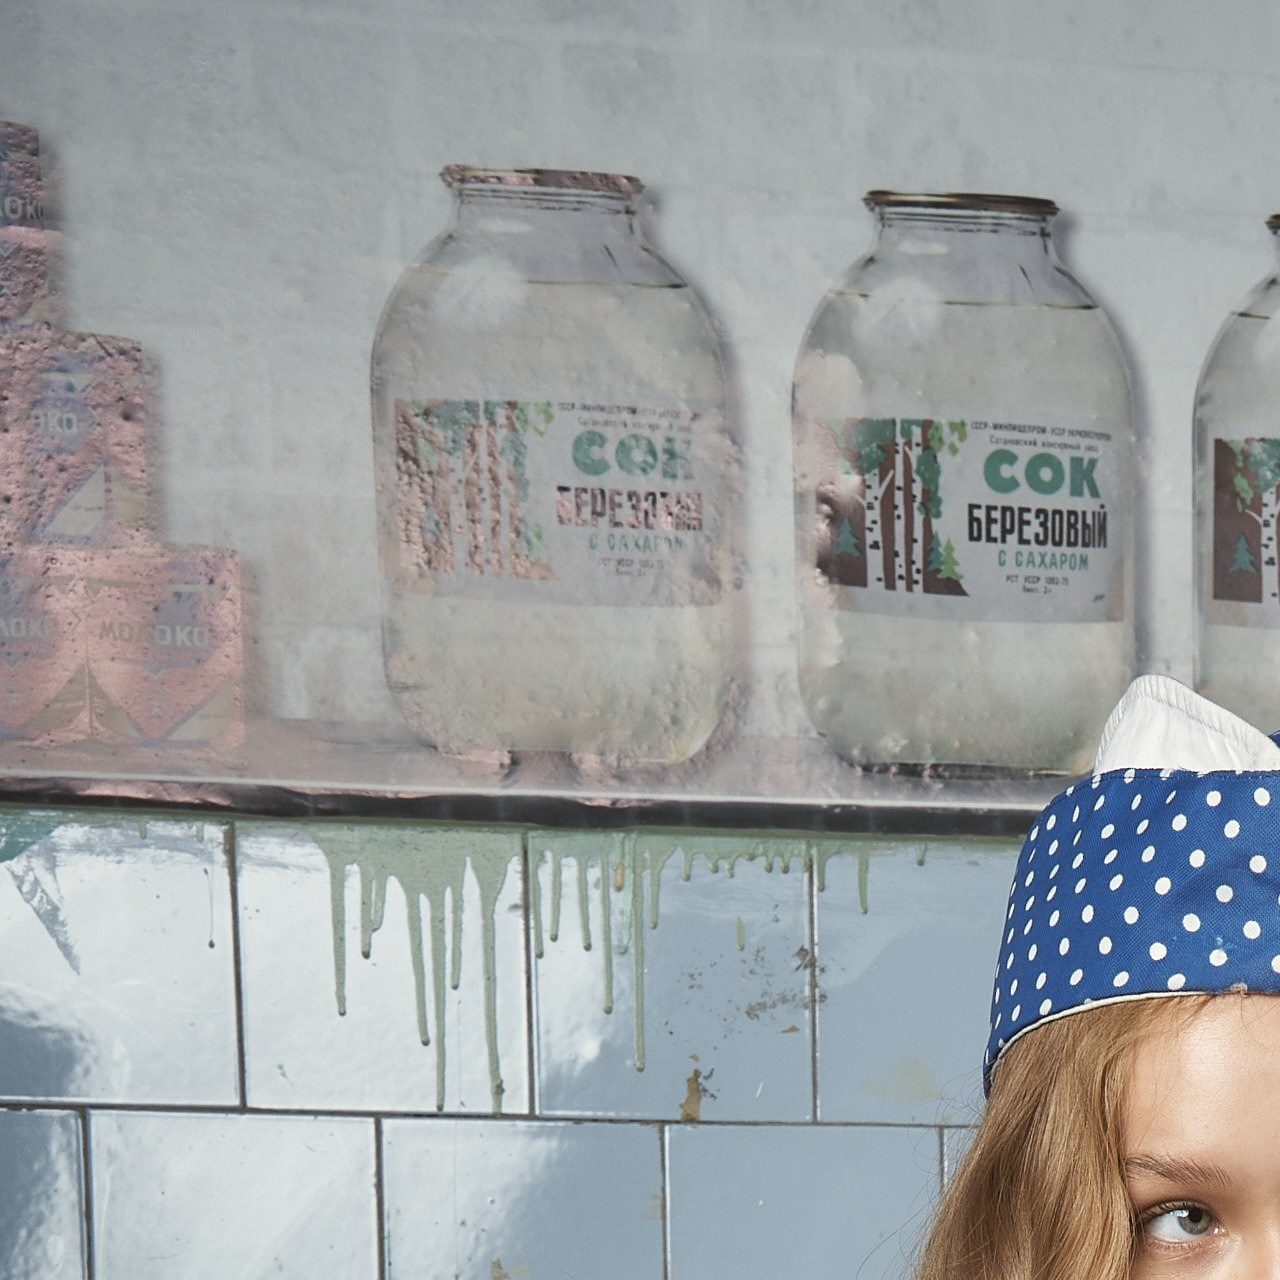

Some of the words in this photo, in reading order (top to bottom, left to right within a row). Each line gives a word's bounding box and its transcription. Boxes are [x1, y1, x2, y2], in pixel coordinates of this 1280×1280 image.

[983, 449, 1101, 499] СОК
[968, 502, 1108, 549] БЕРЕЗОВЫЙ
[998, 550, 1007, 567] С
[1015, 551, 1089, 571] САХАРОМ
